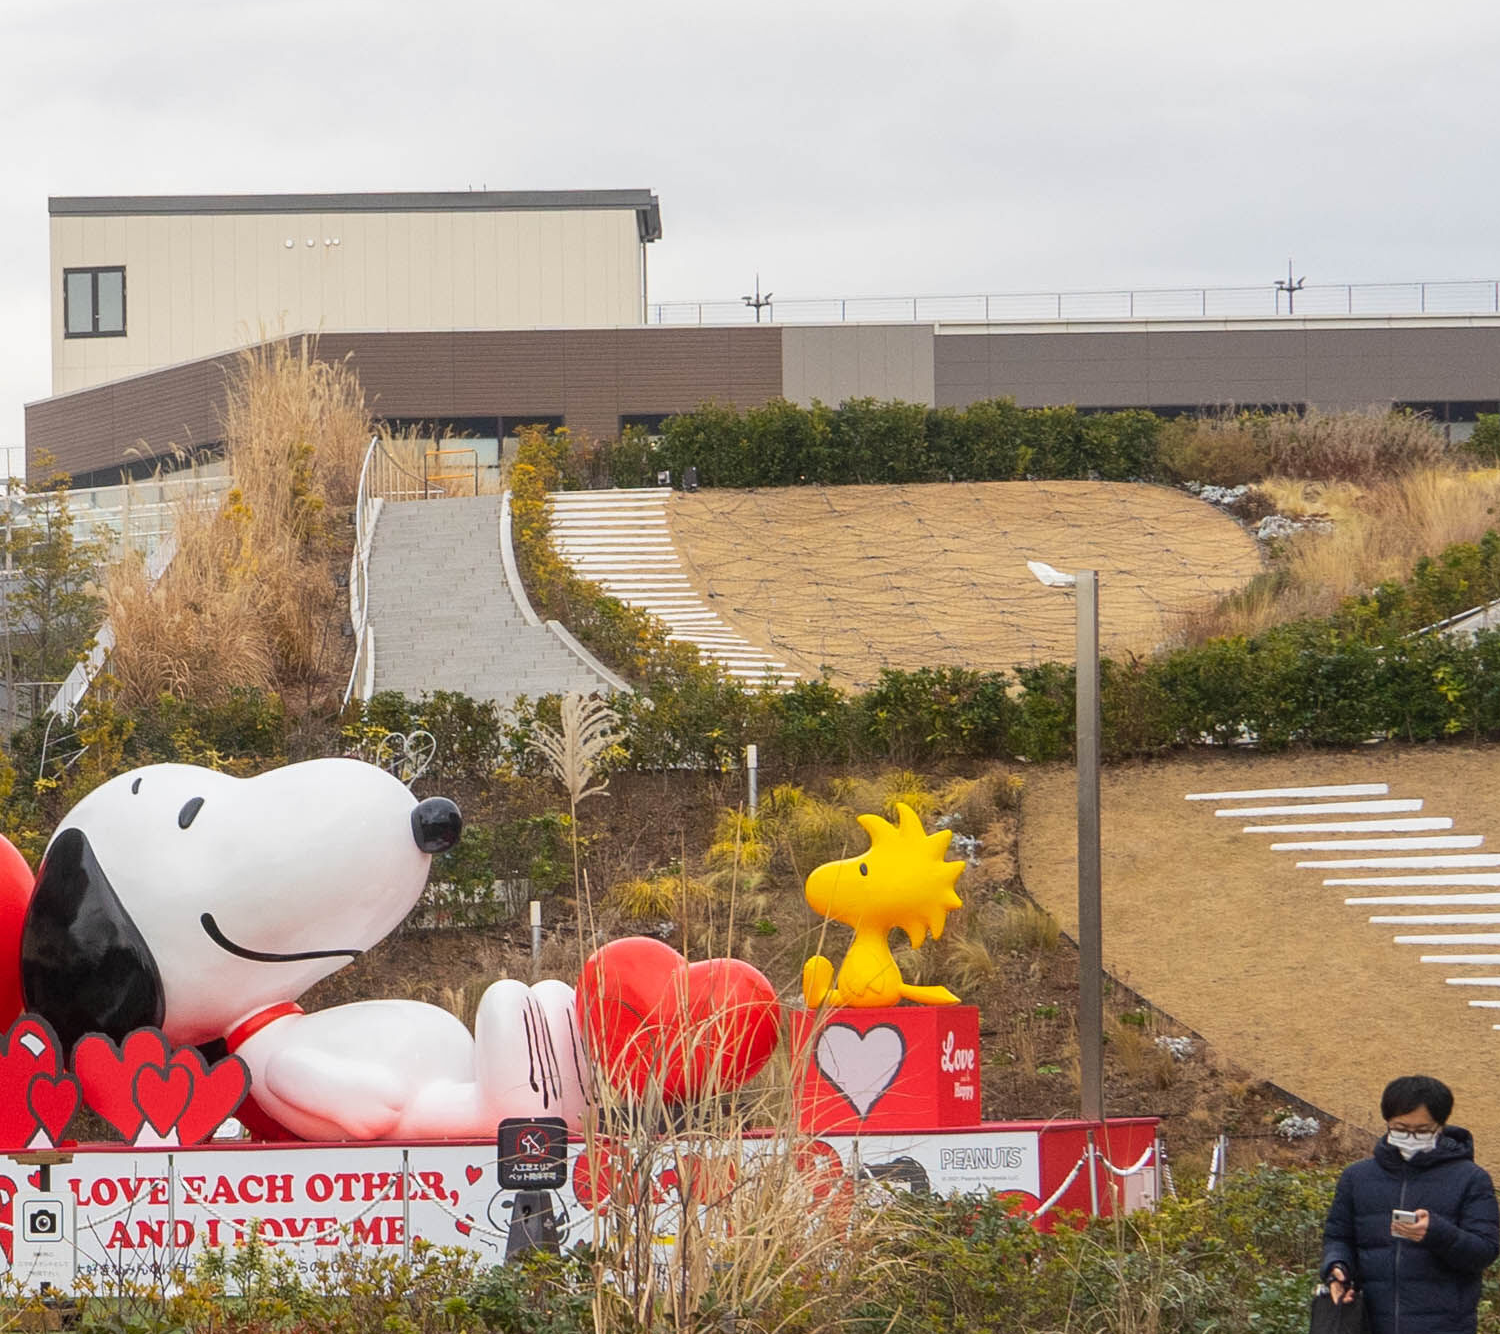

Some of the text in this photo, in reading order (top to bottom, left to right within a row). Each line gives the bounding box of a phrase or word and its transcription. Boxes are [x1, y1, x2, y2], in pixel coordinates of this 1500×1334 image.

[941, 1031, 975, 1073] Love
[953, 1081, 975, 1101] Happy
[940, 1147, 1022, 1170] PEANUTS
[68, 1171, 460, 1208] LOVE EACH OTHER,
[107, 1219, 196, 1250] AND
